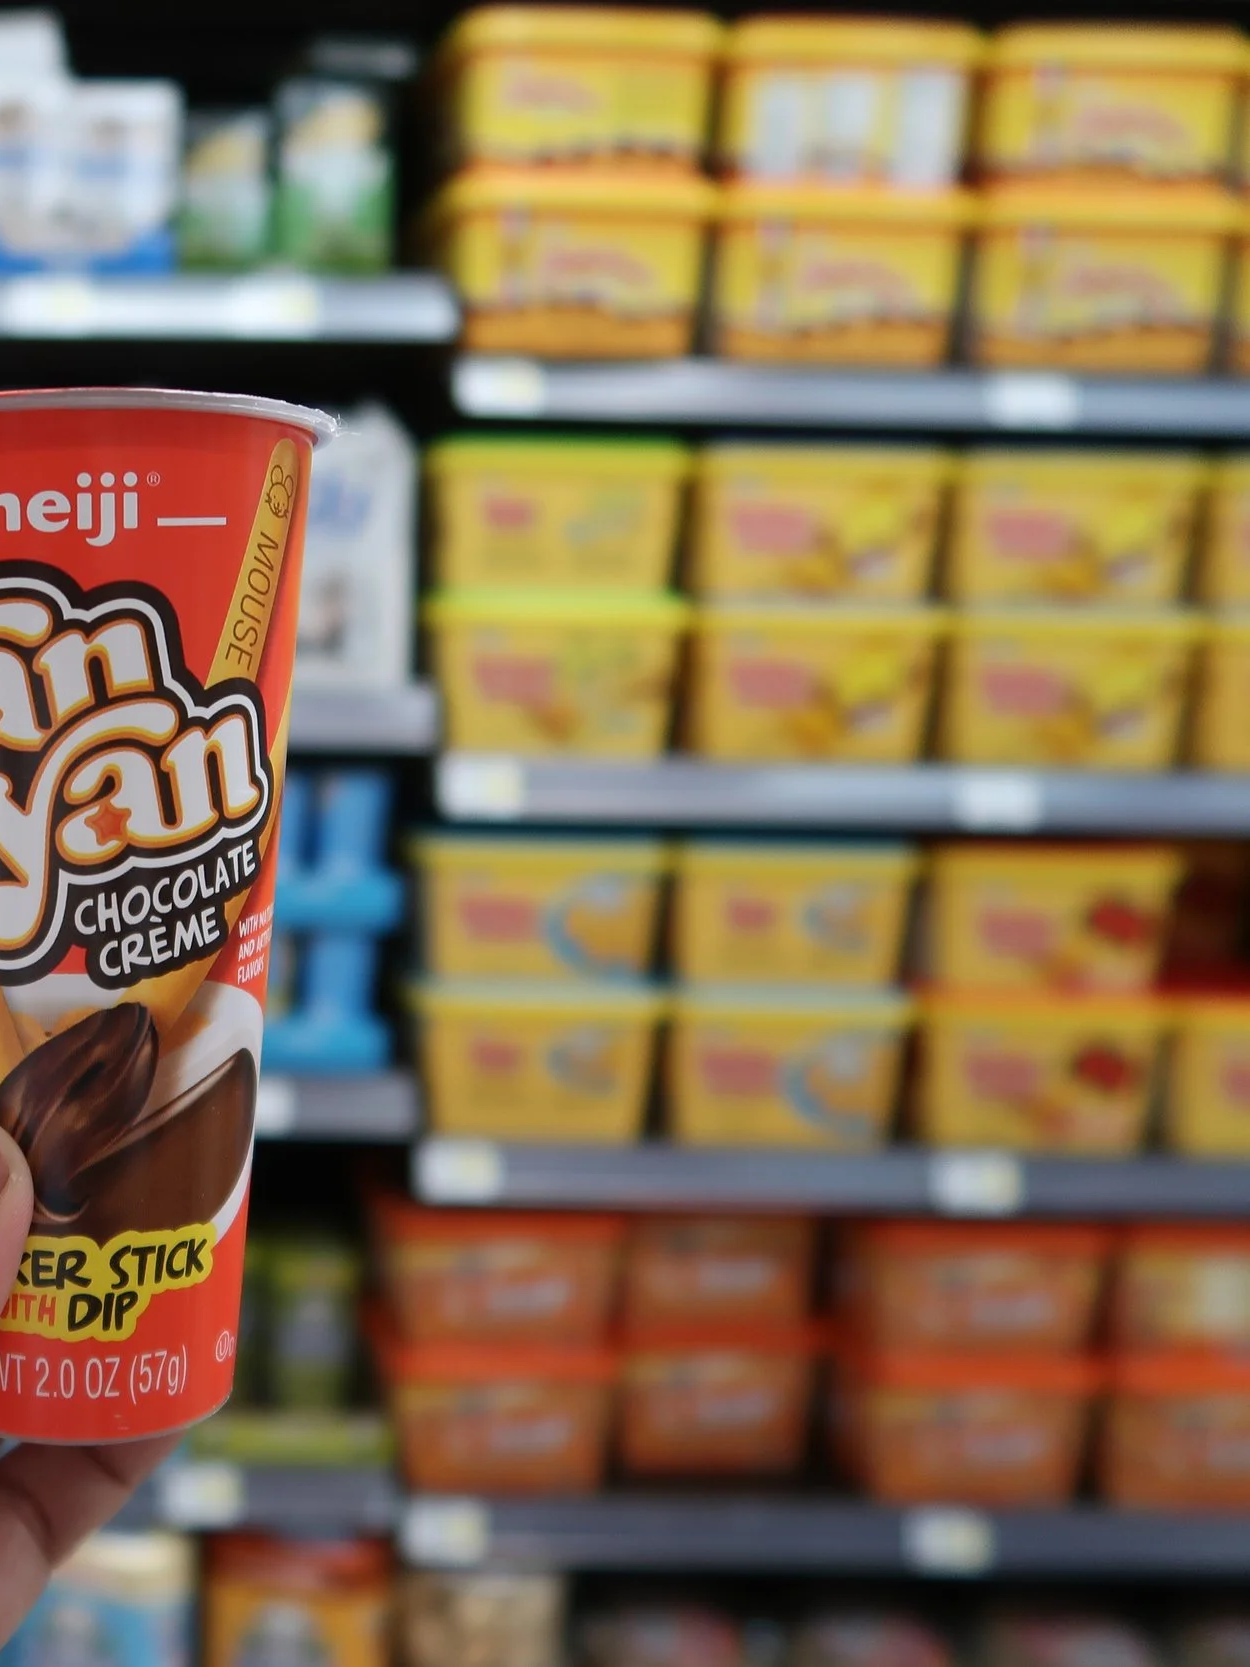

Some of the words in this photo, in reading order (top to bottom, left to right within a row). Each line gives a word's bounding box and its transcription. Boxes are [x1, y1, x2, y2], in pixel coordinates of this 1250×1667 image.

[225, 531, 279, 671] MOUSE
[74, 840, 257, 936] CHOCOLATE
[99, 906, 221, 977] CRÈME
[238, 939, 255, 962] AND
[16, 1249, 92, 1290] KER
[109, 1238, 210, 1290] STICK
[68, 1291, 139, 1332] DIP
[35, 1356, 76, 1400] 2.0
[85, 1356, 121, 1400] OZ
[129, 1344, 188, 1406] (57g)
